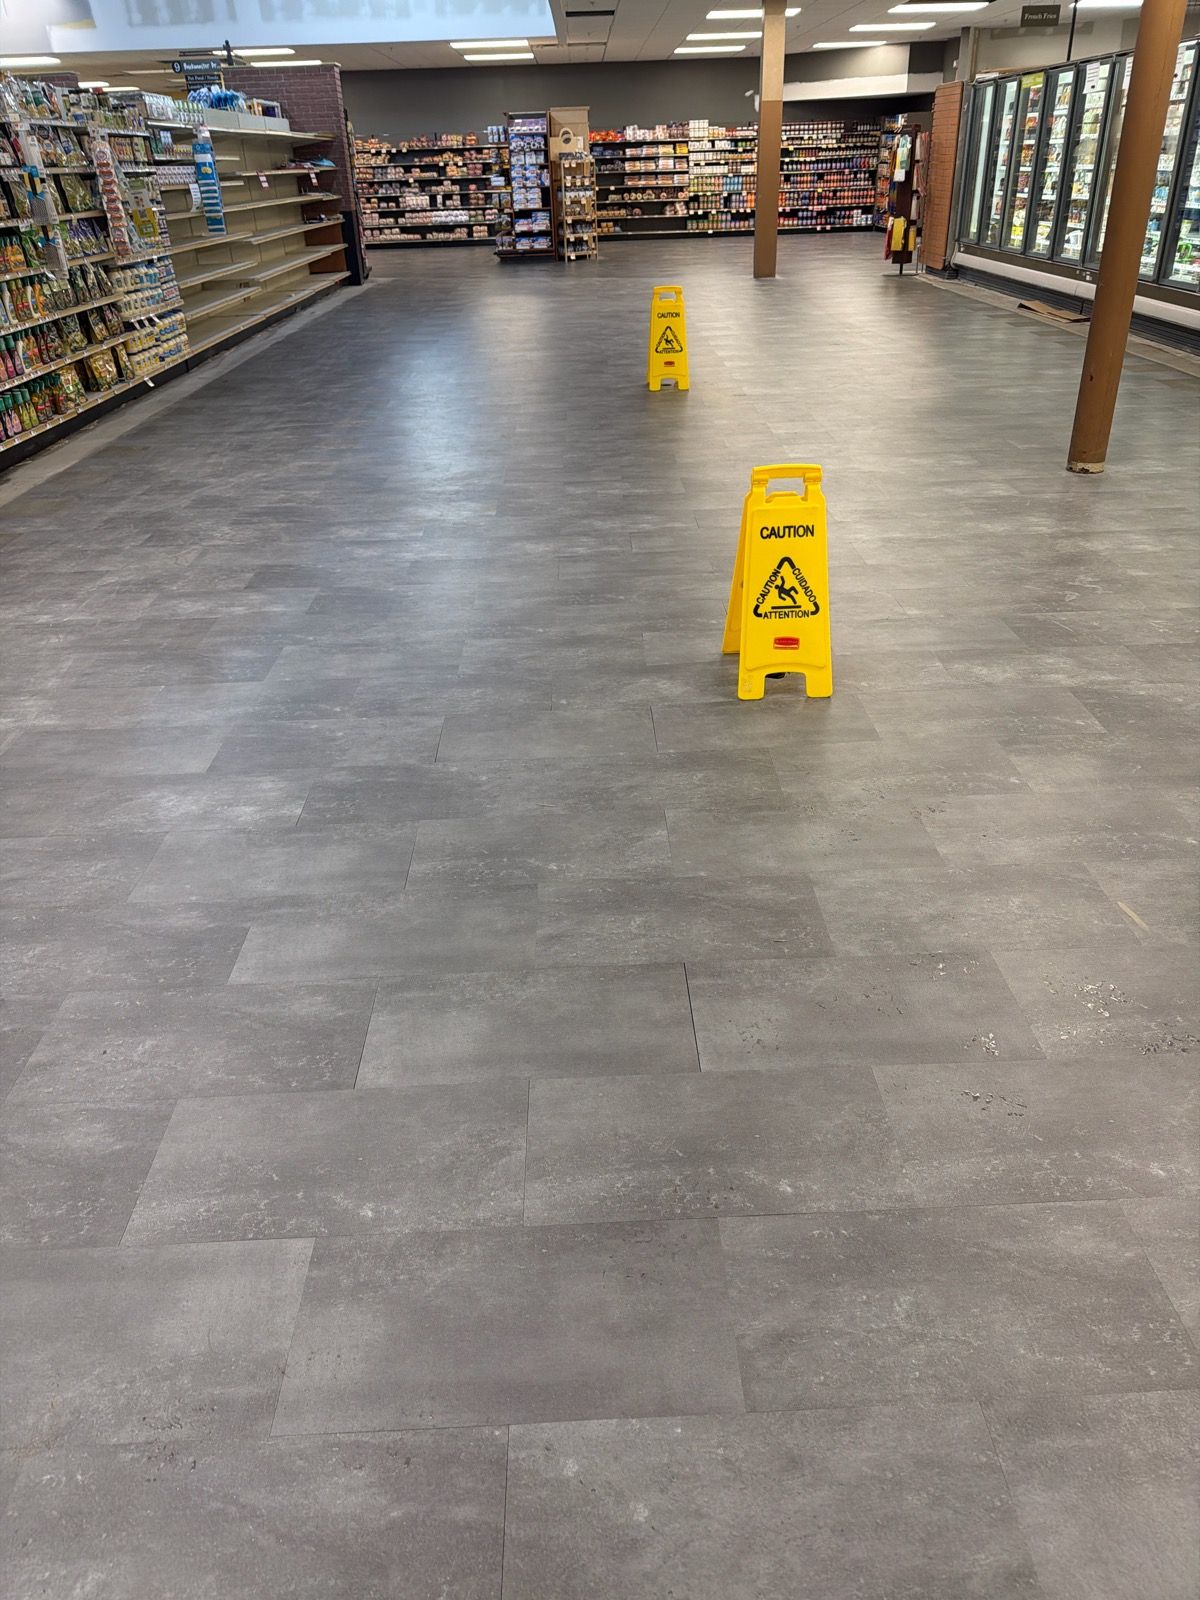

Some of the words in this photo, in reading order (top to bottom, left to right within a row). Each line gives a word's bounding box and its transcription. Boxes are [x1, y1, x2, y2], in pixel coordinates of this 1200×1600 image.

[174, 62, 181, 72] 9
[760, 524, 815, 540] CAUTION
[756, 568, 781, 605] CAUTION
[792, 567, 817, 603] CUIDADO
[762, 610, 810, 620] ATTENTION
